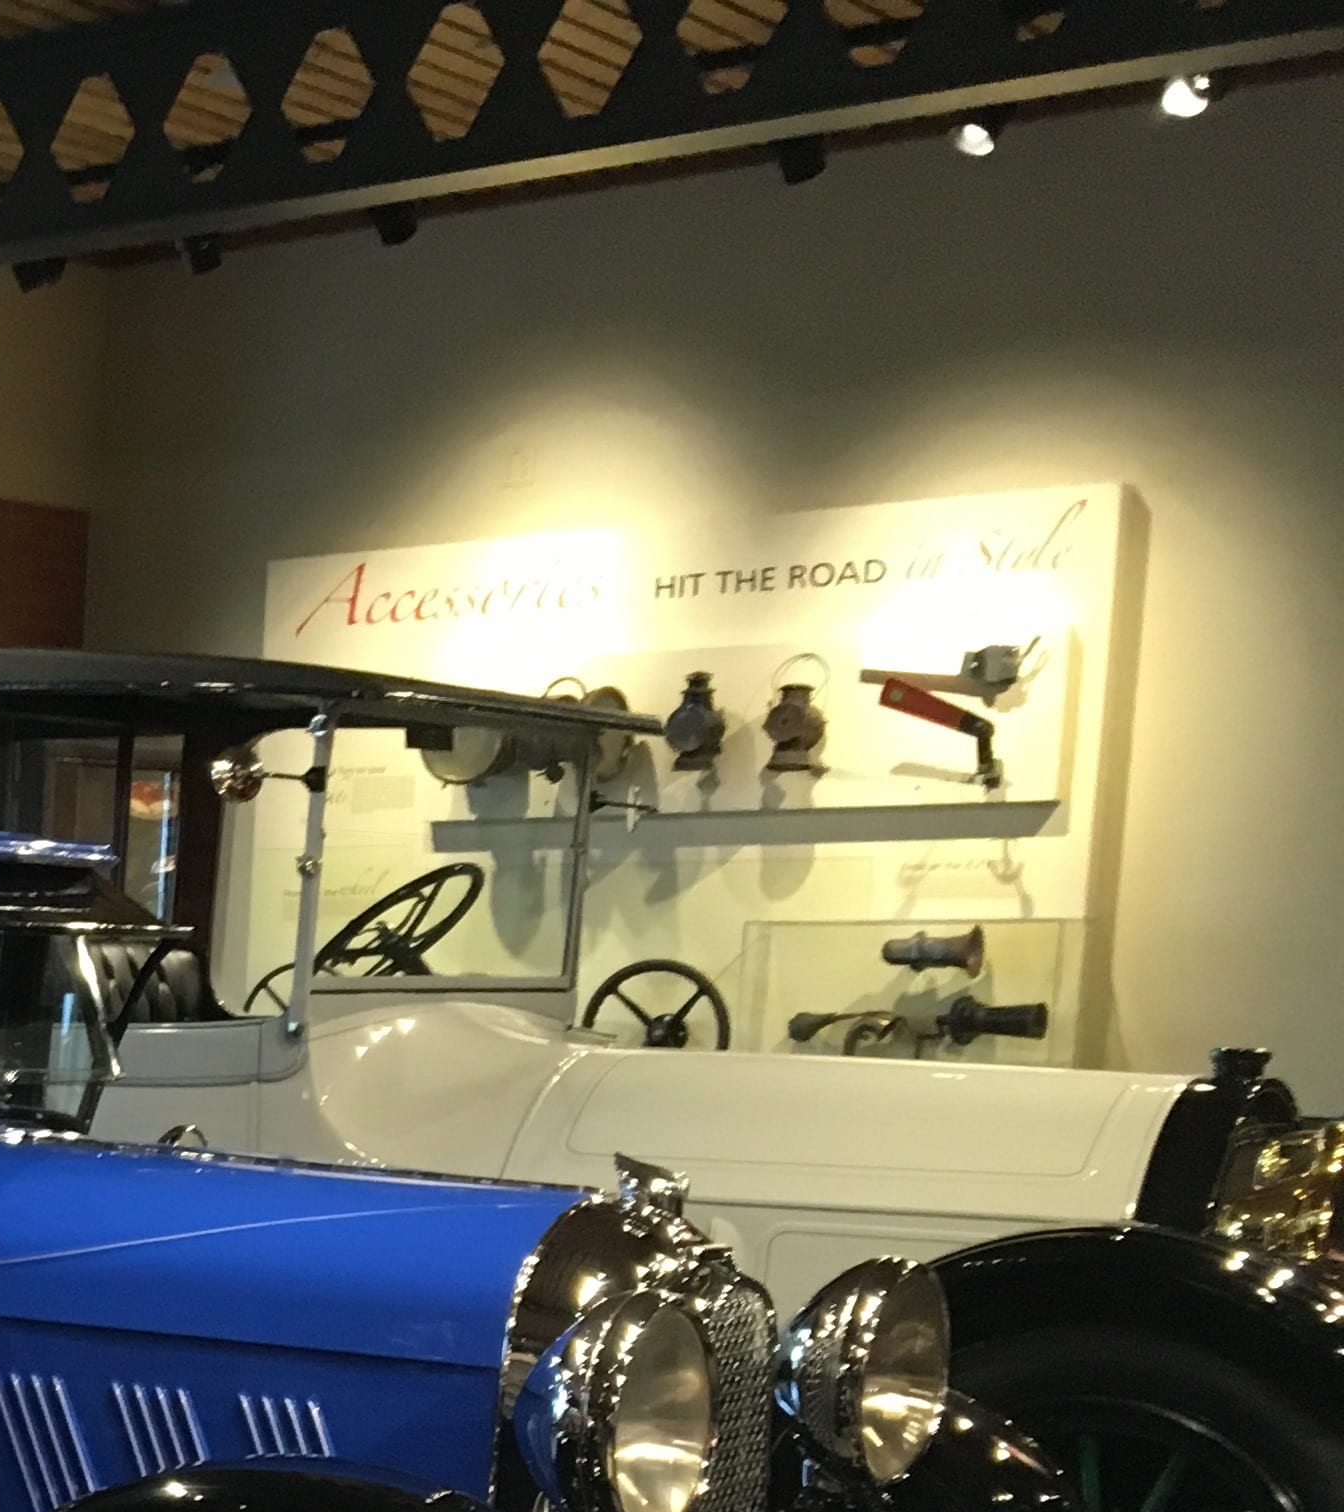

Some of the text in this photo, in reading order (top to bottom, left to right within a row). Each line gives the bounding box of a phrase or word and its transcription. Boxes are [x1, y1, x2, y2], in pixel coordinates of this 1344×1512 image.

[654, 572, 706, 600] HIT
[716, 566, 777, 595] THE
[787, 558, 888, 591] ROAD
